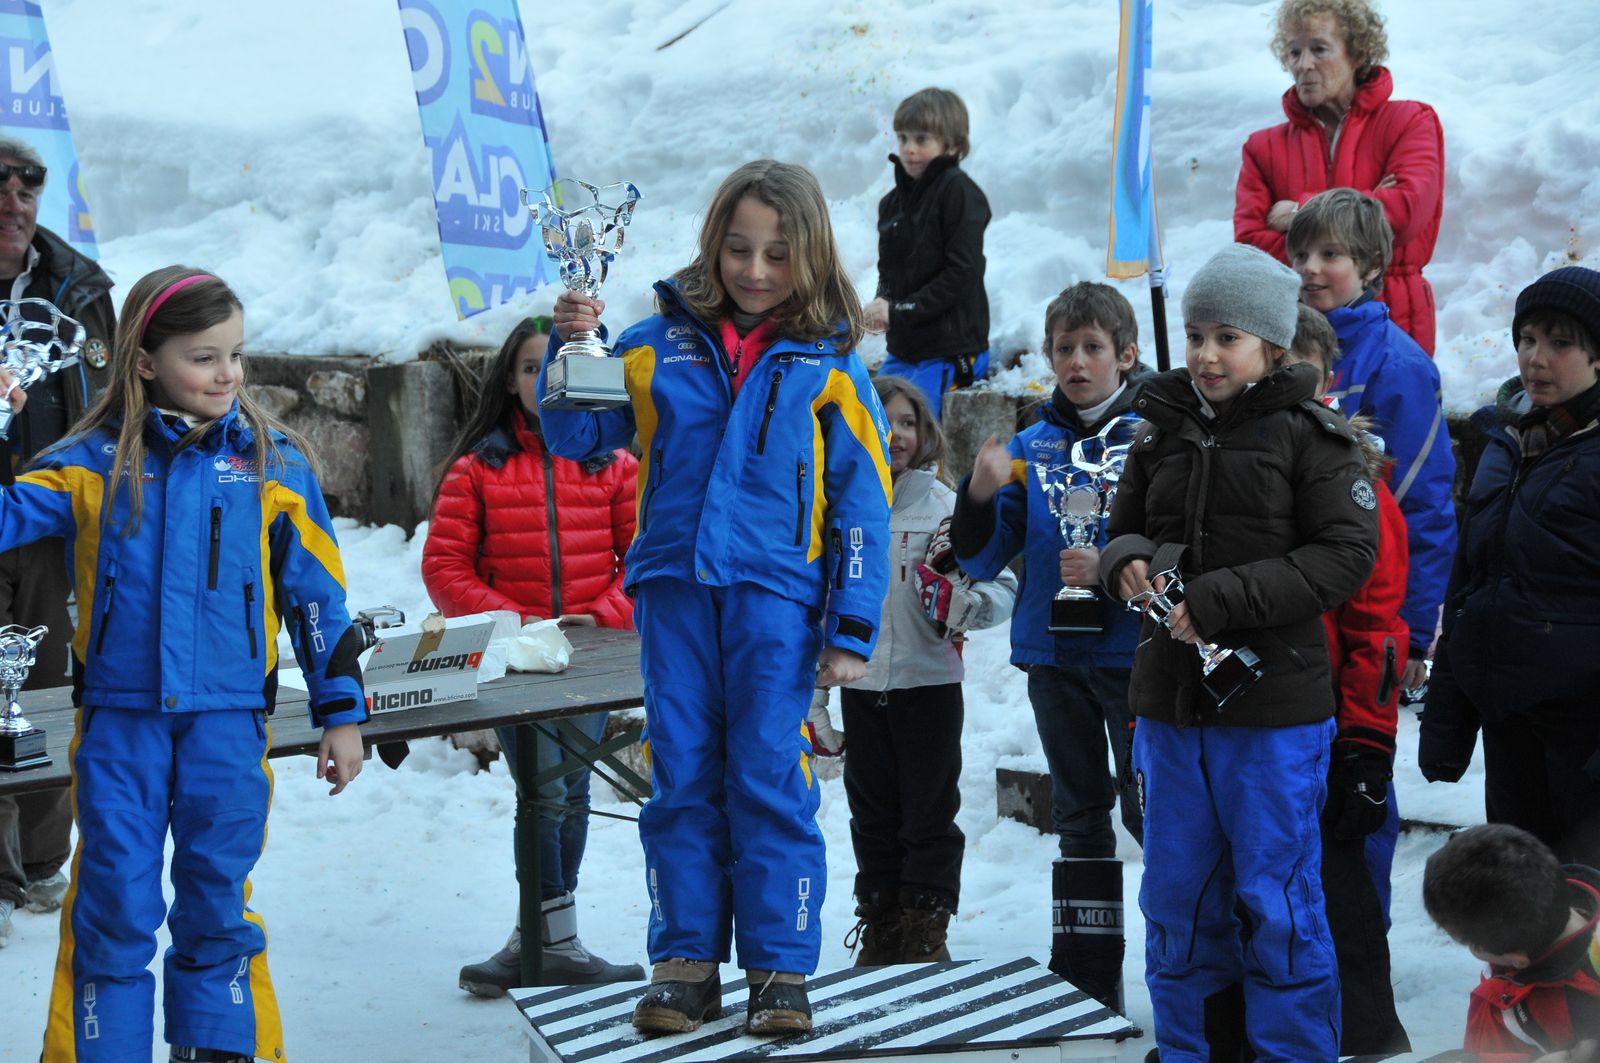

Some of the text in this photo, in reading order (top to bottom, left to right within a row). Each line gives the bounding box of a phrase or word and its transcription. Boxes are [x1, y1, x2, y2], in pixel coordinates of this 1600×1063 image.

[663, 354, 710, 364] BONALDI
[849, 527, 863, 578] DKB
[308, 602, 326, 652] DKB
[406, 651, 483, 674] bticino
[796, 877, 810, 932] DKB
[229, 956, 248, 1005] DKB
[83, 982, 99, 1040] DKB
